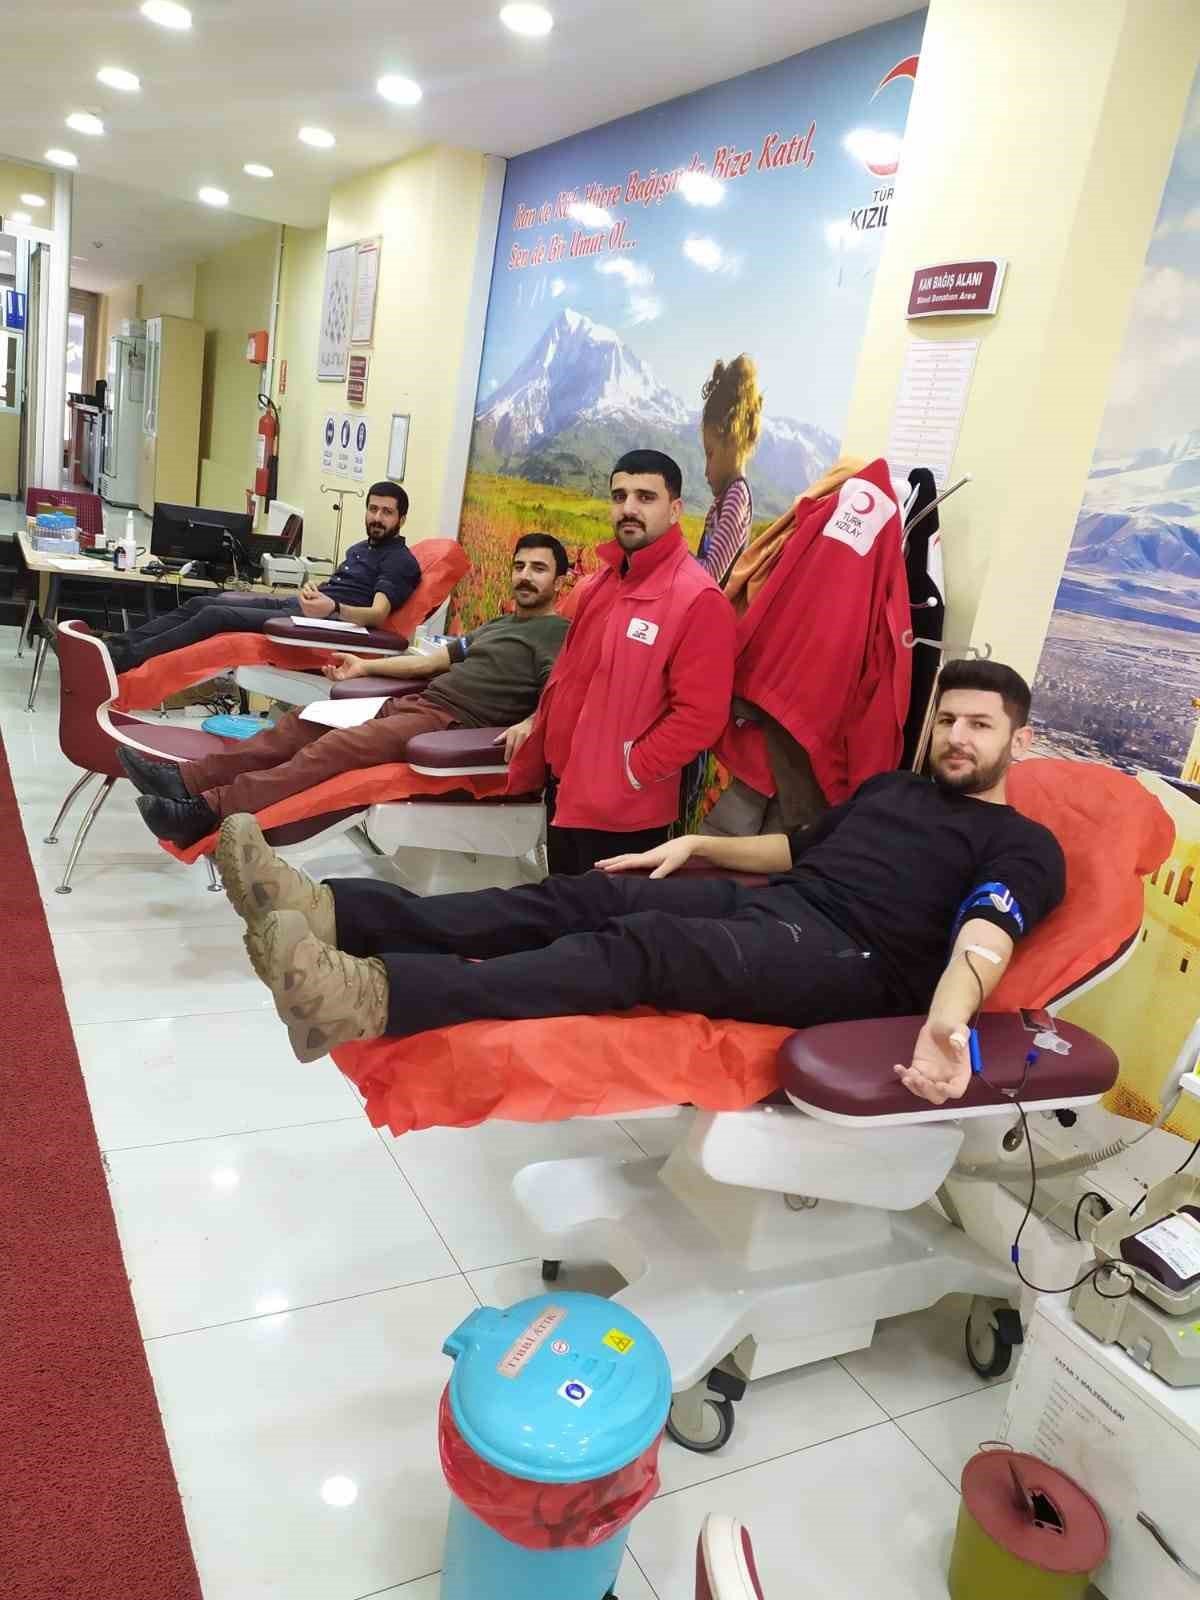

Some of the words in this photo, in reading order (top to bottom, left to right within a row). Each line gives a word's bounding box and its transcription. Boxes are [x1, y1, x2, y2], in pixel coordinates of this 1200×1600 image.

[712, 145, 752, 179] Bize
[756, 120, 816, 170] Katıl,
[955, 271, 983, 288] ALANI
